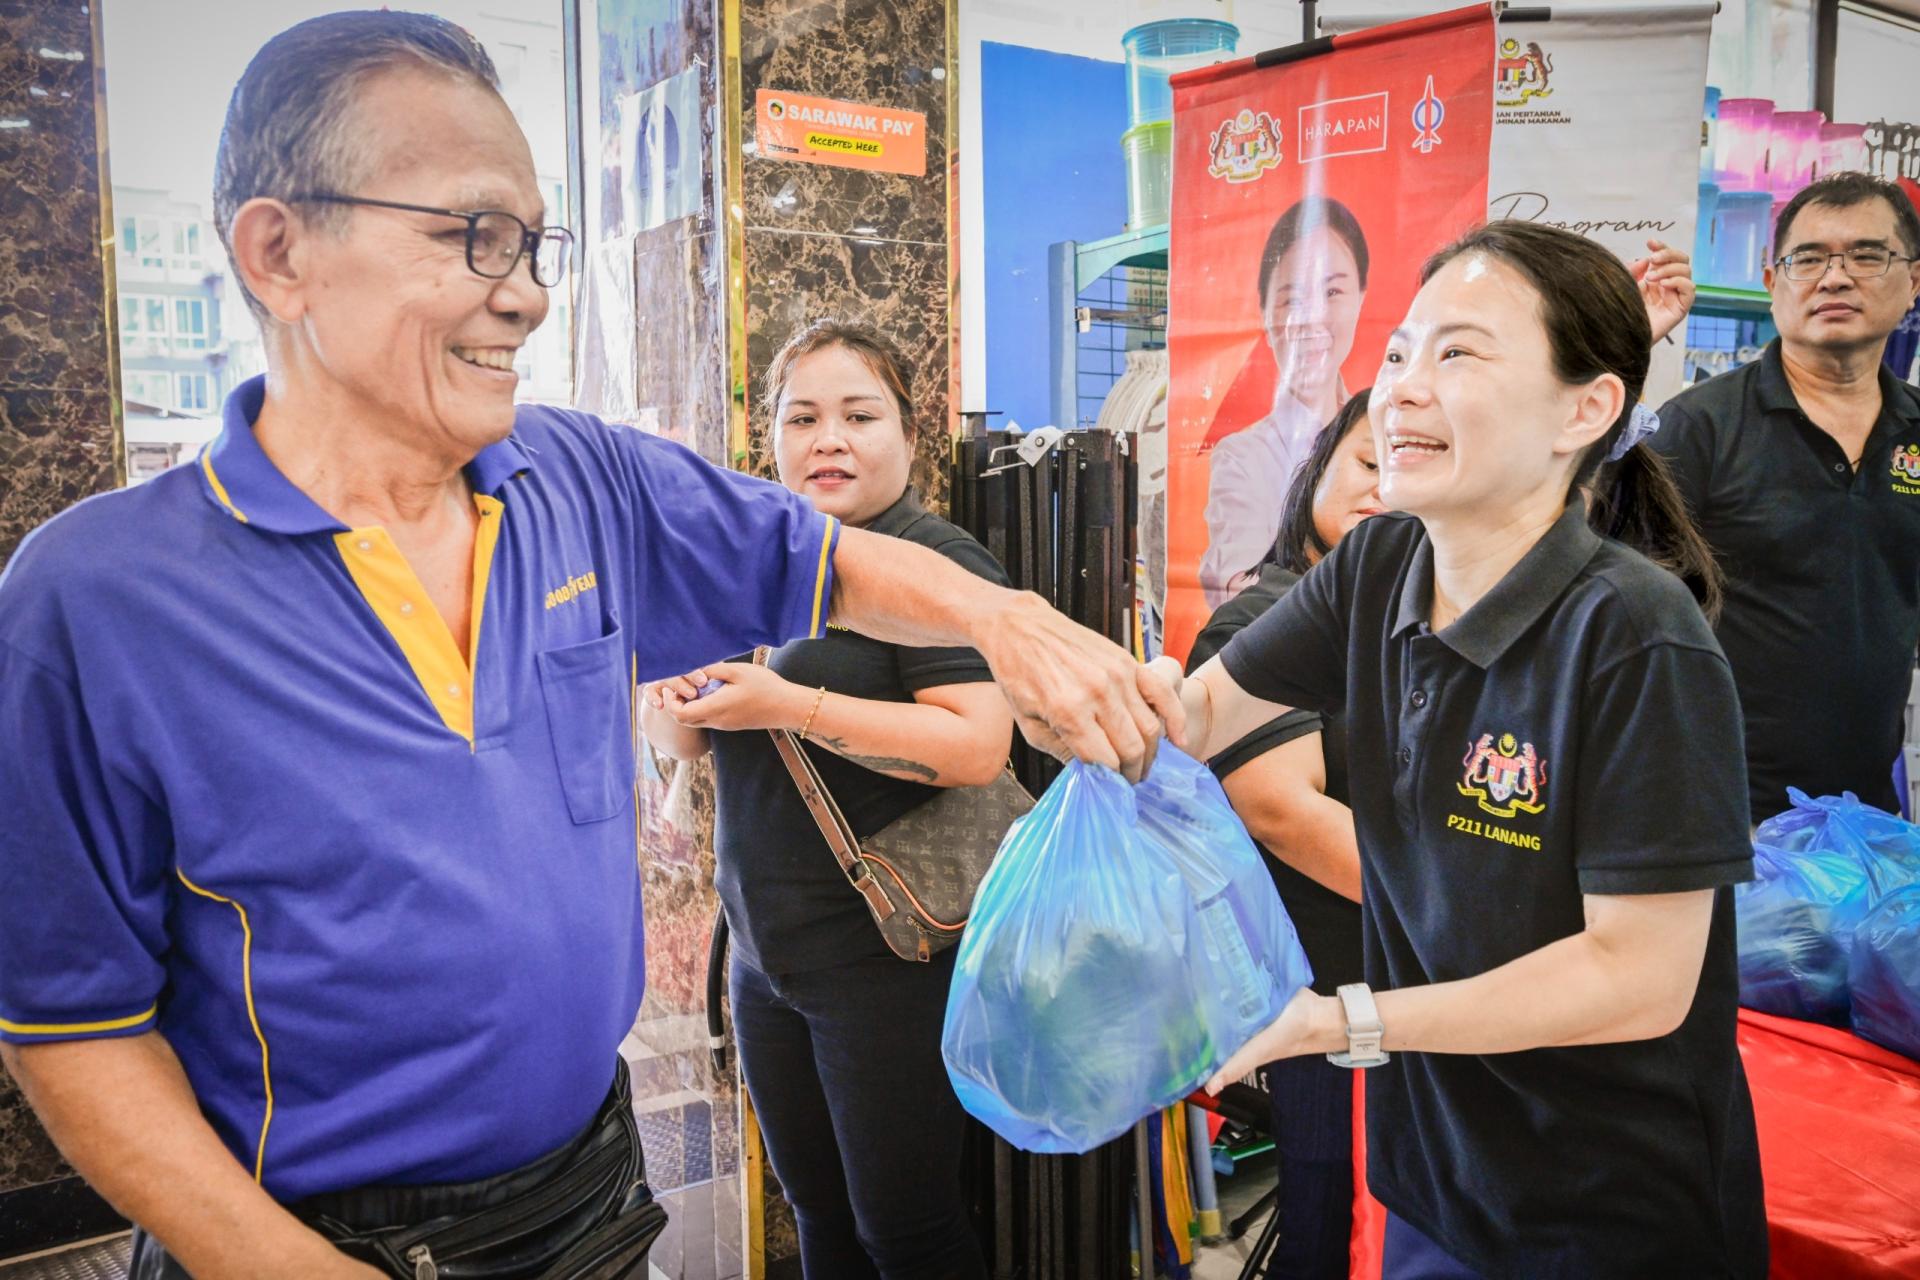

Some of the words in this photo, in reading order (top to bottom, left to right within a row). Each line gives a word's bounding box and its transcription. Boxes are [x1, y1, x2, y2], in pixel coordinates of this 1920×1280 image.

[788, 105, 878, 131] SARAWAK
[882, 117, 914, 137] PAY
[1513, 110, 1561, 118] PERTANIAN
[1304, 115, 1381, 141] HARAPAN
[809, 135, 853, 149] ACCEPTED
[855, 141, 879, 153] HERE
[1447, 814, 1482, 836] P211
[1484, 824, 1541, 851] LANANG
